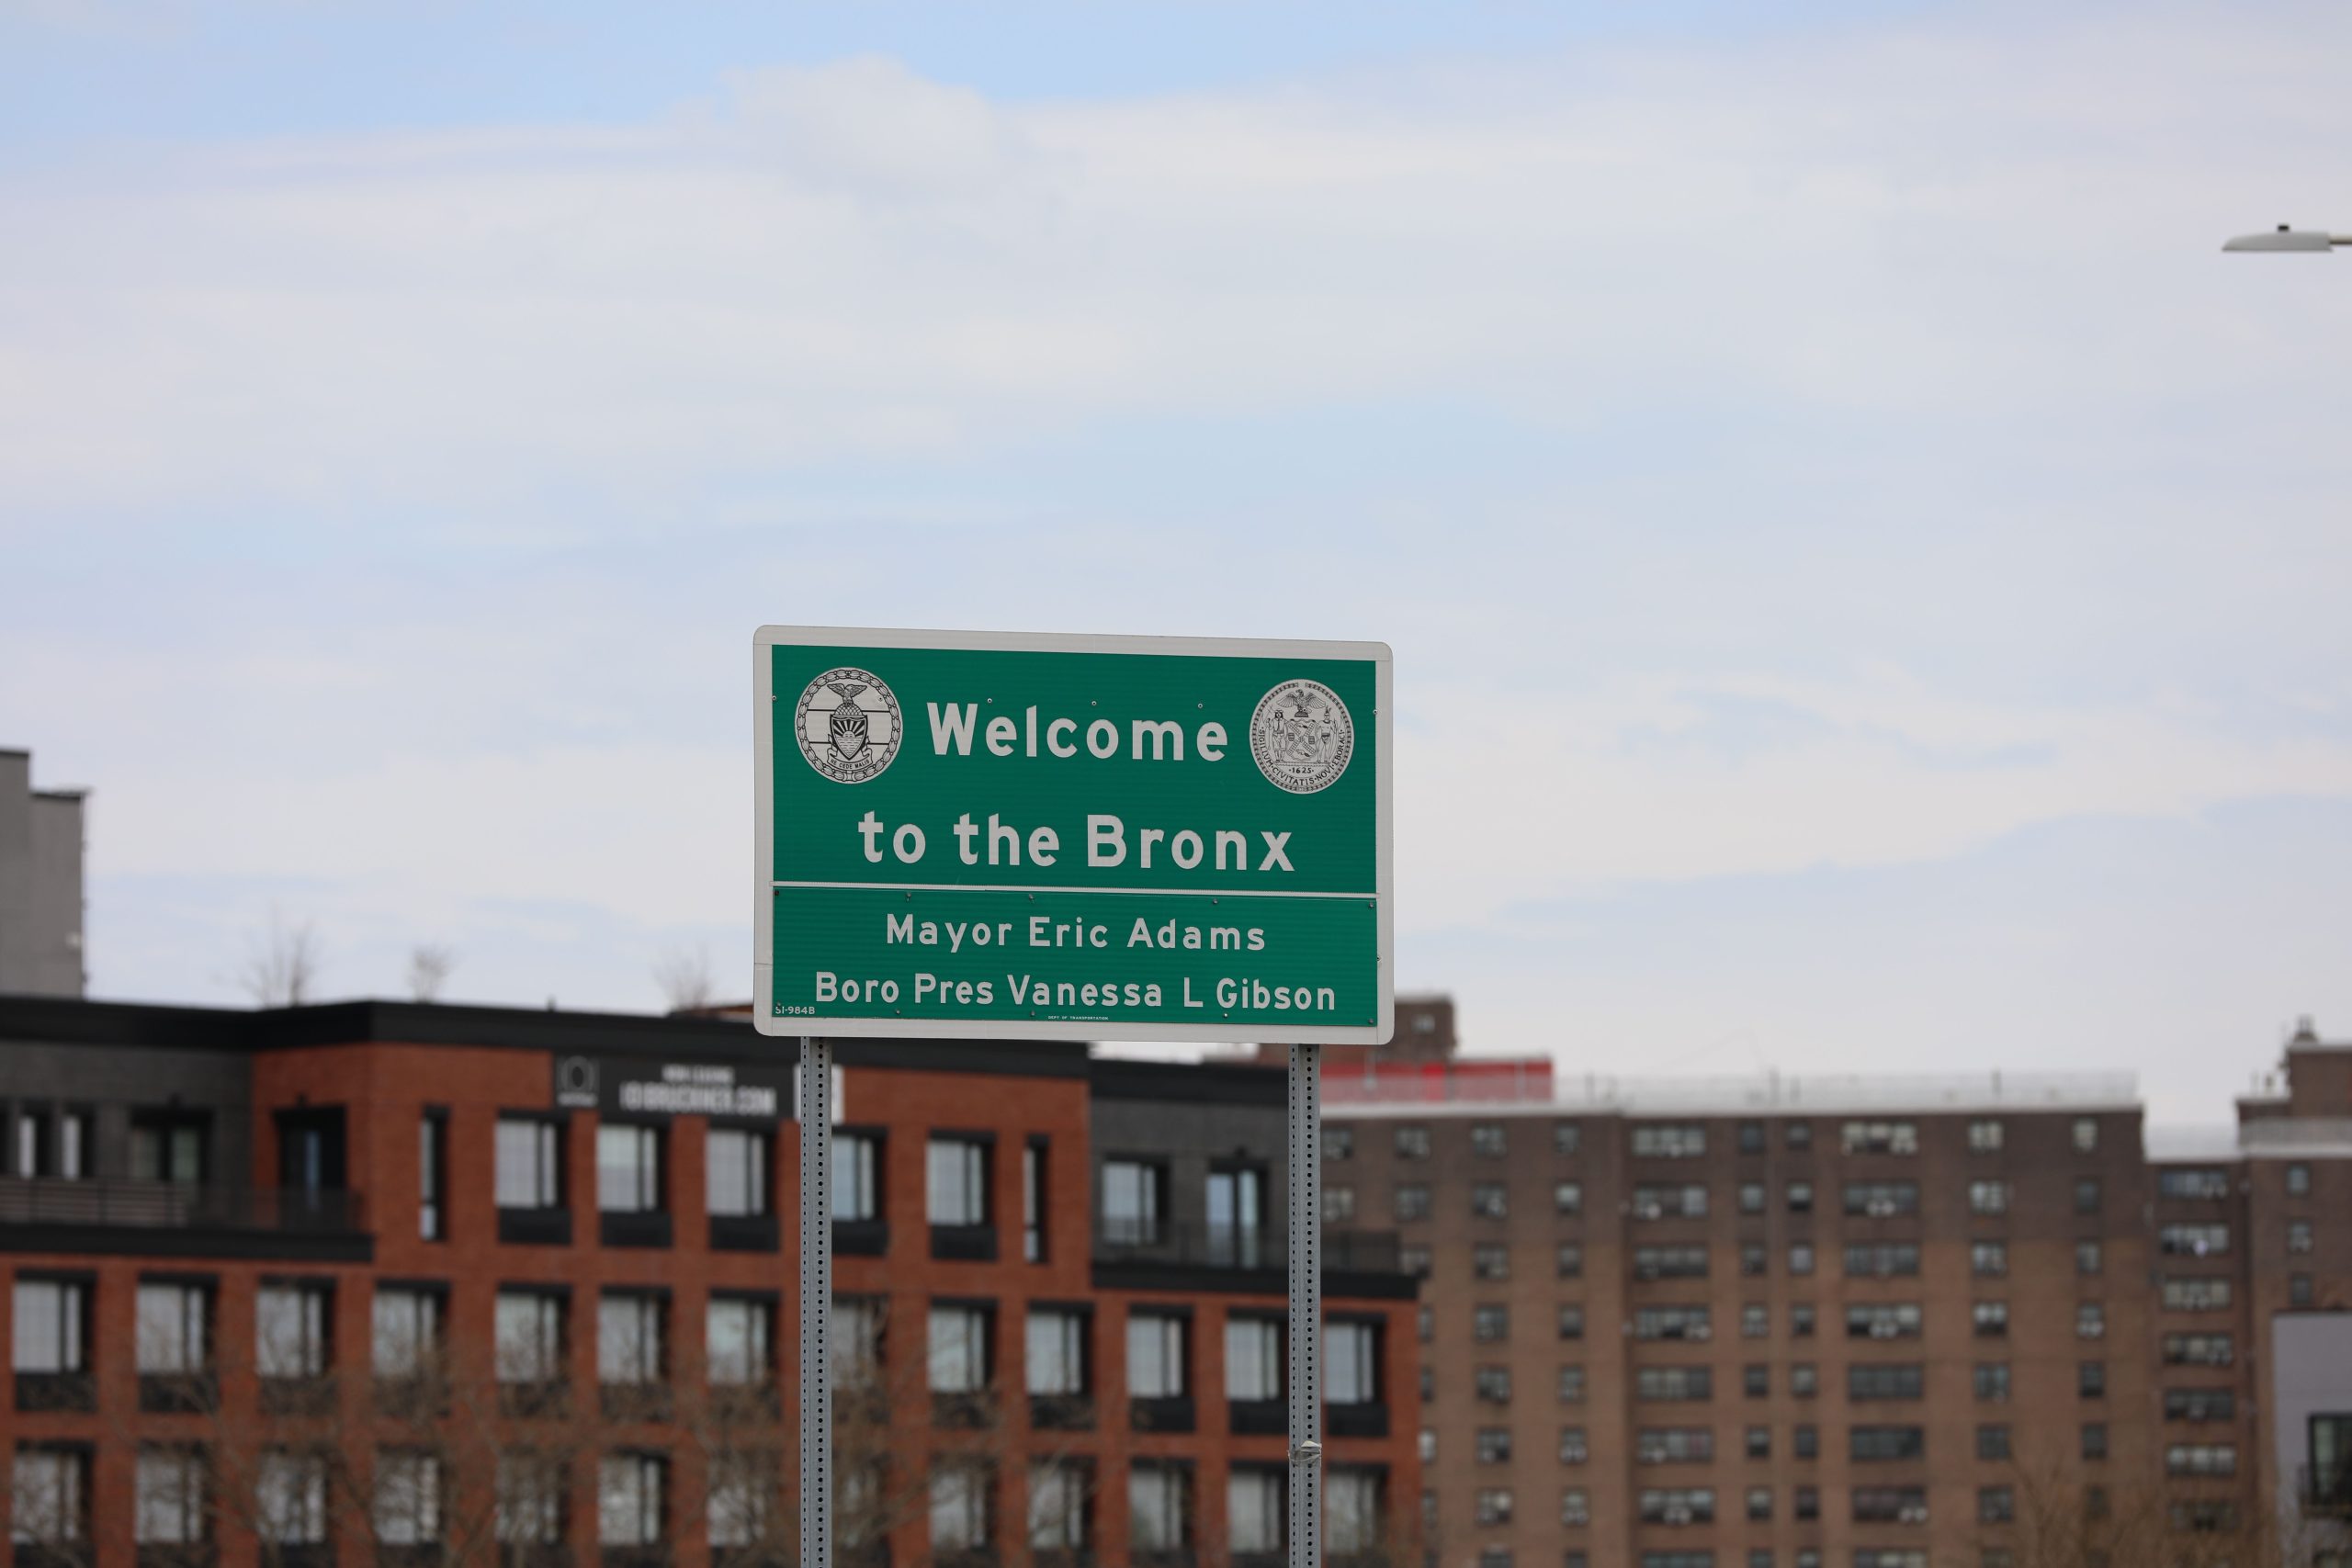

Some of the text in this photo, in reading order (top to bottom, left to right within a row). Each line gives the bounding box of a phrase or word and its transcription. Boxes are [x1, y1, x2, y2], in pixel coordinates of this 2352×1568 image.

[927, 702, 1228, 761] Welcome
[857, 810, 1295, 872] to the Bronx
[887, 913, 1265, 953] Mayor Eric Adams
[775, 1006, 816, 1015] SI-984B
[816, 971, 1335, 1010] Boro Pres Vanessa L Gibson
